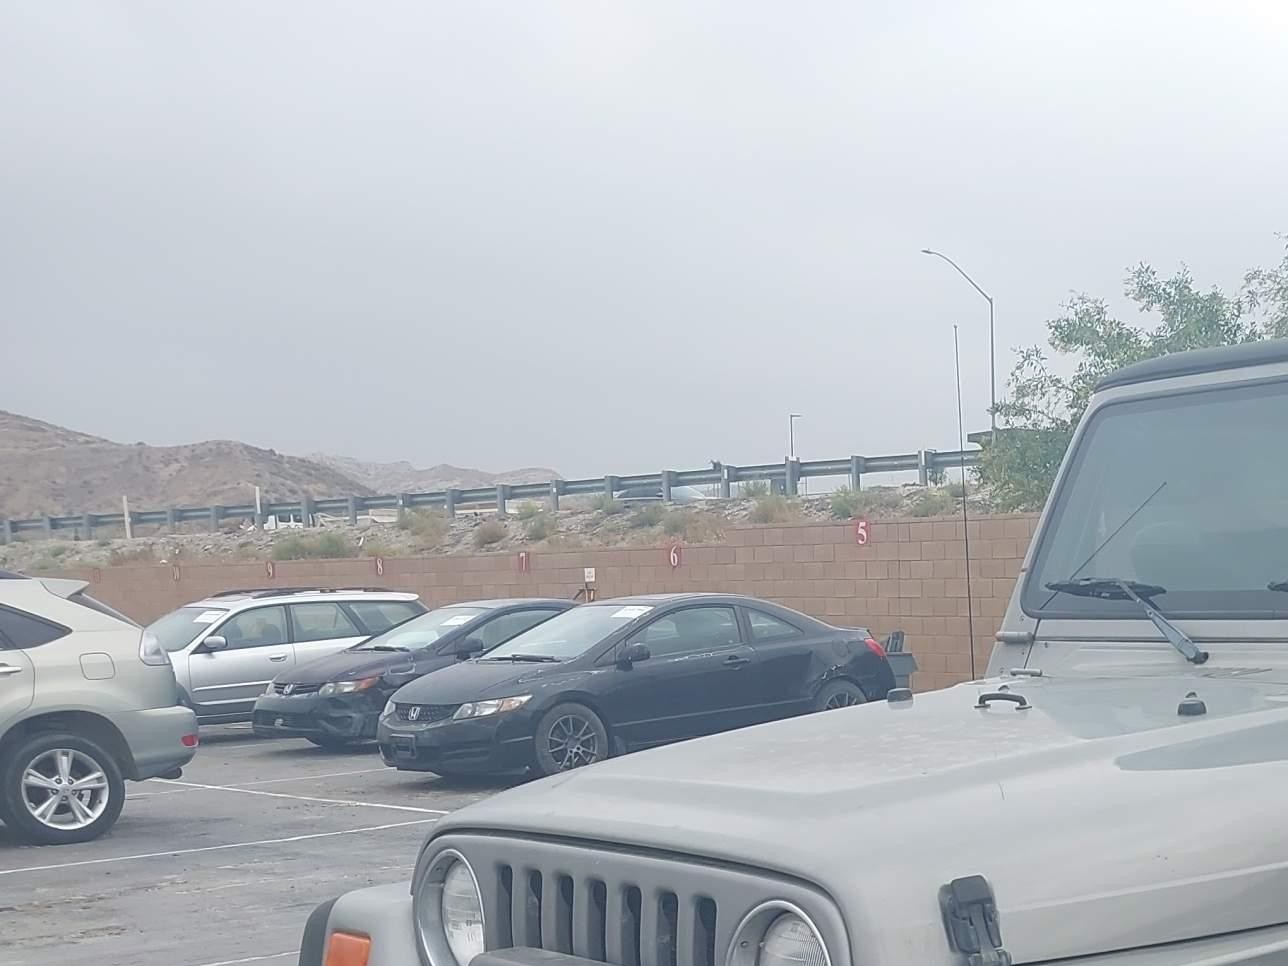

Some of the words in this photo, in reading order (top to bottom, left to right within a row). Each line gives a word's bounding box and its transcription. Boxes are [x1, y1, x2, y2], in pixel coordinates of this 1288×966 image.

[856, 521, 868, 545] 5
[376, 557, 384, 577] 8
[669, 545, 679, 567] 6
